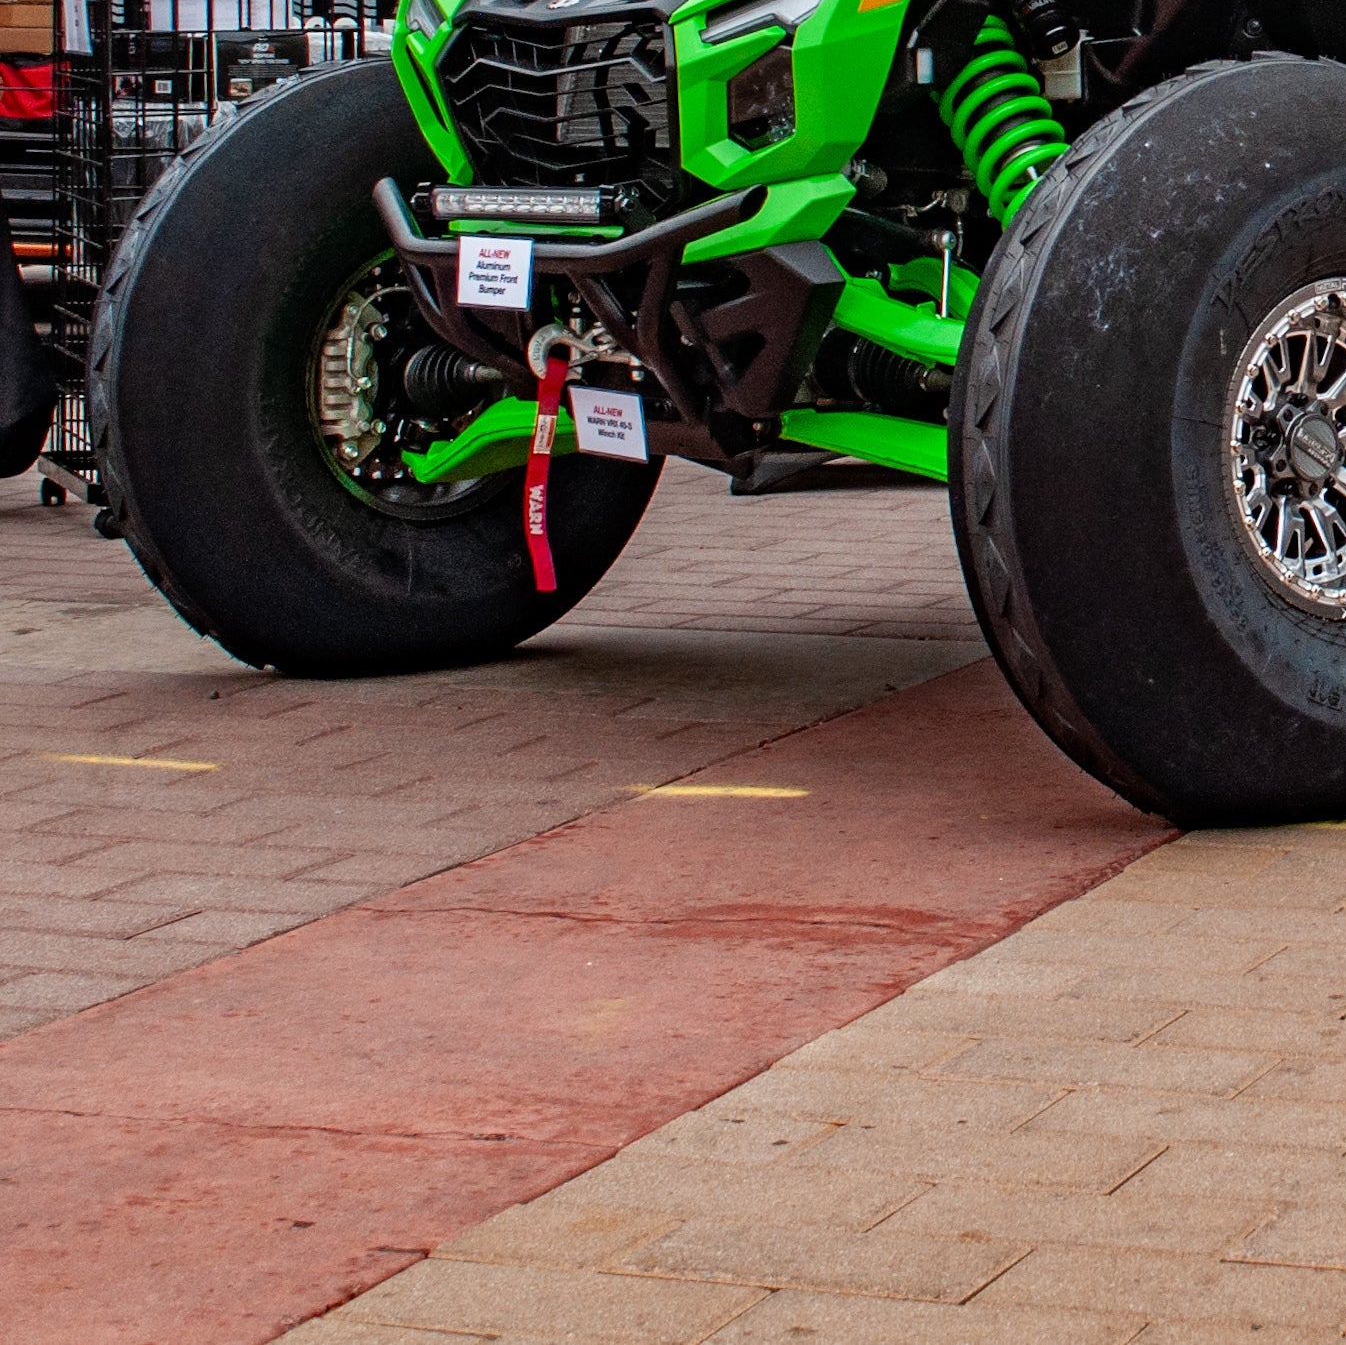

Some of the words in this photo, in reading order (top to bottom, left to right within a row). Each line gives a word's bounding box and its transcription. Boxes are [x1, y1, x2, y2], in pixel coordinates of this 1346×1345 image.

[478, 248, 511, 260] ALL-NEW
[476, 260, 511, 271] Aluminum
[468, 271, 498, 282] Premium
[500, 274, 518, 284] Front
[478, 284, 506, 296] Bumper
[593, 405, 623, 417] ALL-NEW
[529, 485, 545, 536] WARN
